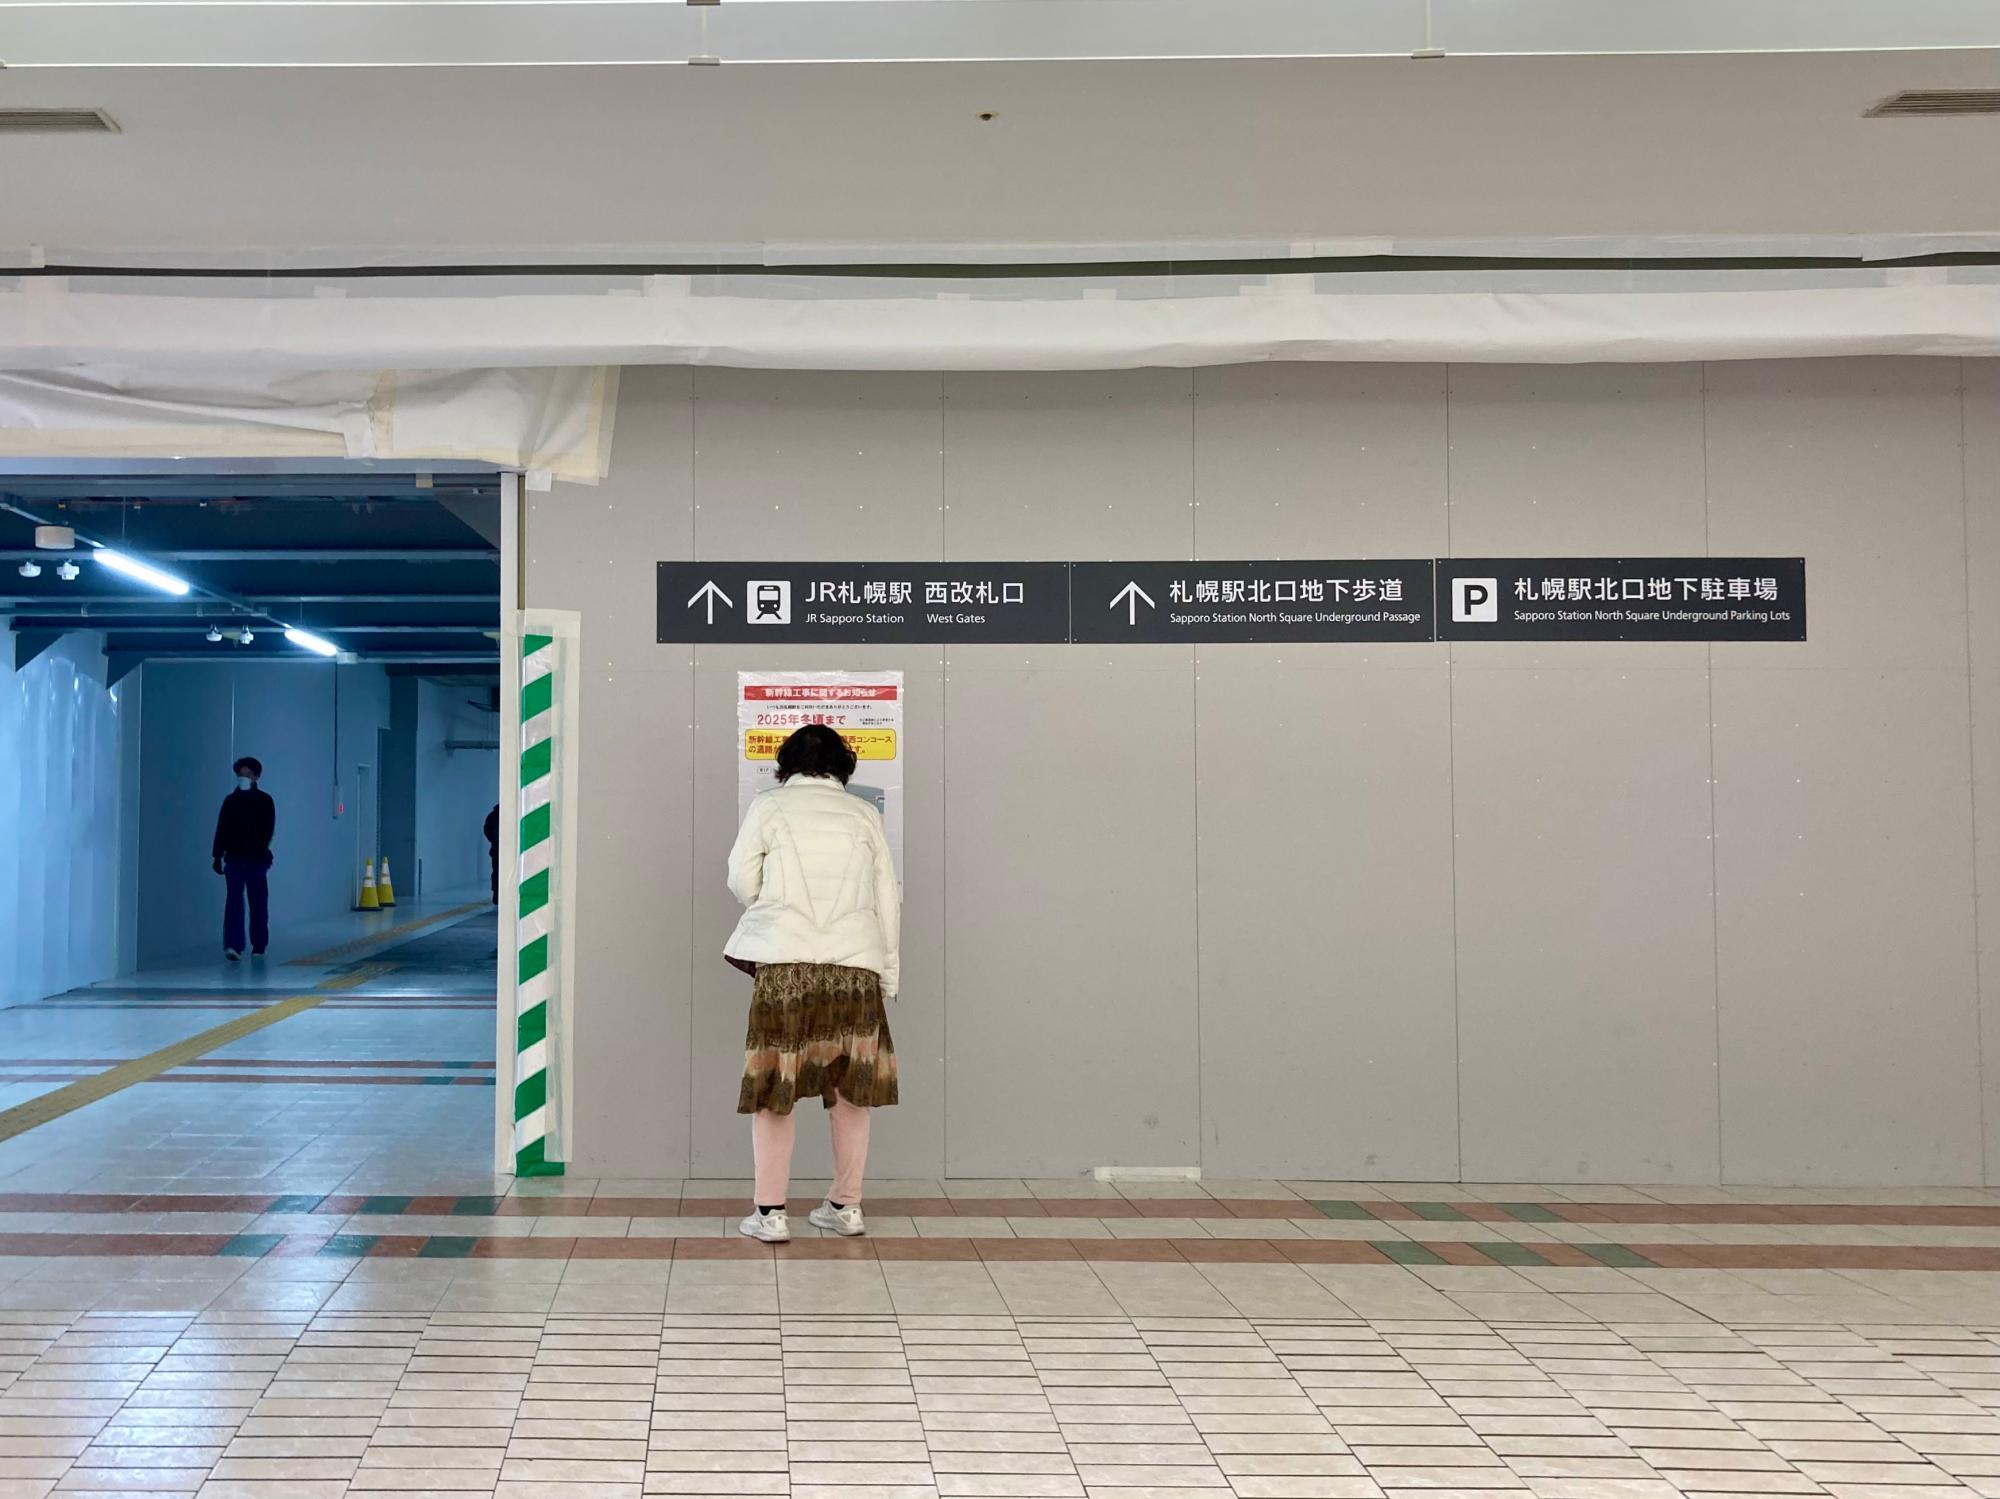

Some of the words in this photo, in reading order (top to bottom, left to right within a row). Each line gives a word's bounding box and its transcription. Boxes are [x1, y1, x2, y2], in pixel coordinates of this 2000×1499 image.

[804, 580, 913, 605] JR札幌駅
[924, 580, 1024, 605] 西改札口
[1169, 578, 1403, 604] 札幌駅北口地下歩道
[1514, 576, 1778, 602] 札幌駅北口地下駐車場
[1464, 584, 1488, 616] P
[805, 612, 818, 625] JR
[819, 613, 864, 626] Sapporo
[865, 612, 905, 624] Station
[926, 613, 954, 624] West
[955, 613, 986, 624] Gates
[1169, 612, 1211, 625] Sapporo
[1212, 612, 1247, 623] Station
[1248, 611, 1277, 623] North
[1278, 612, 1313, 625] Square
[1314, 611, 1381, 625] Underground
[1382, 611, 1421, 624] Passage
[1513, 610, 1556, 623] Sapporo
[1557, 609, 1593, 621] Station
[1594, 609, 1624, 621] North
[1625, 610, 1660, 623] Square
[1662, 609, 1729, 623] Underground
[1730, 610, 1768, 623] Parking
[1769, 610, 1791, 621] Lots
[757, 713, 846, 725] 2025年冬頃まで
